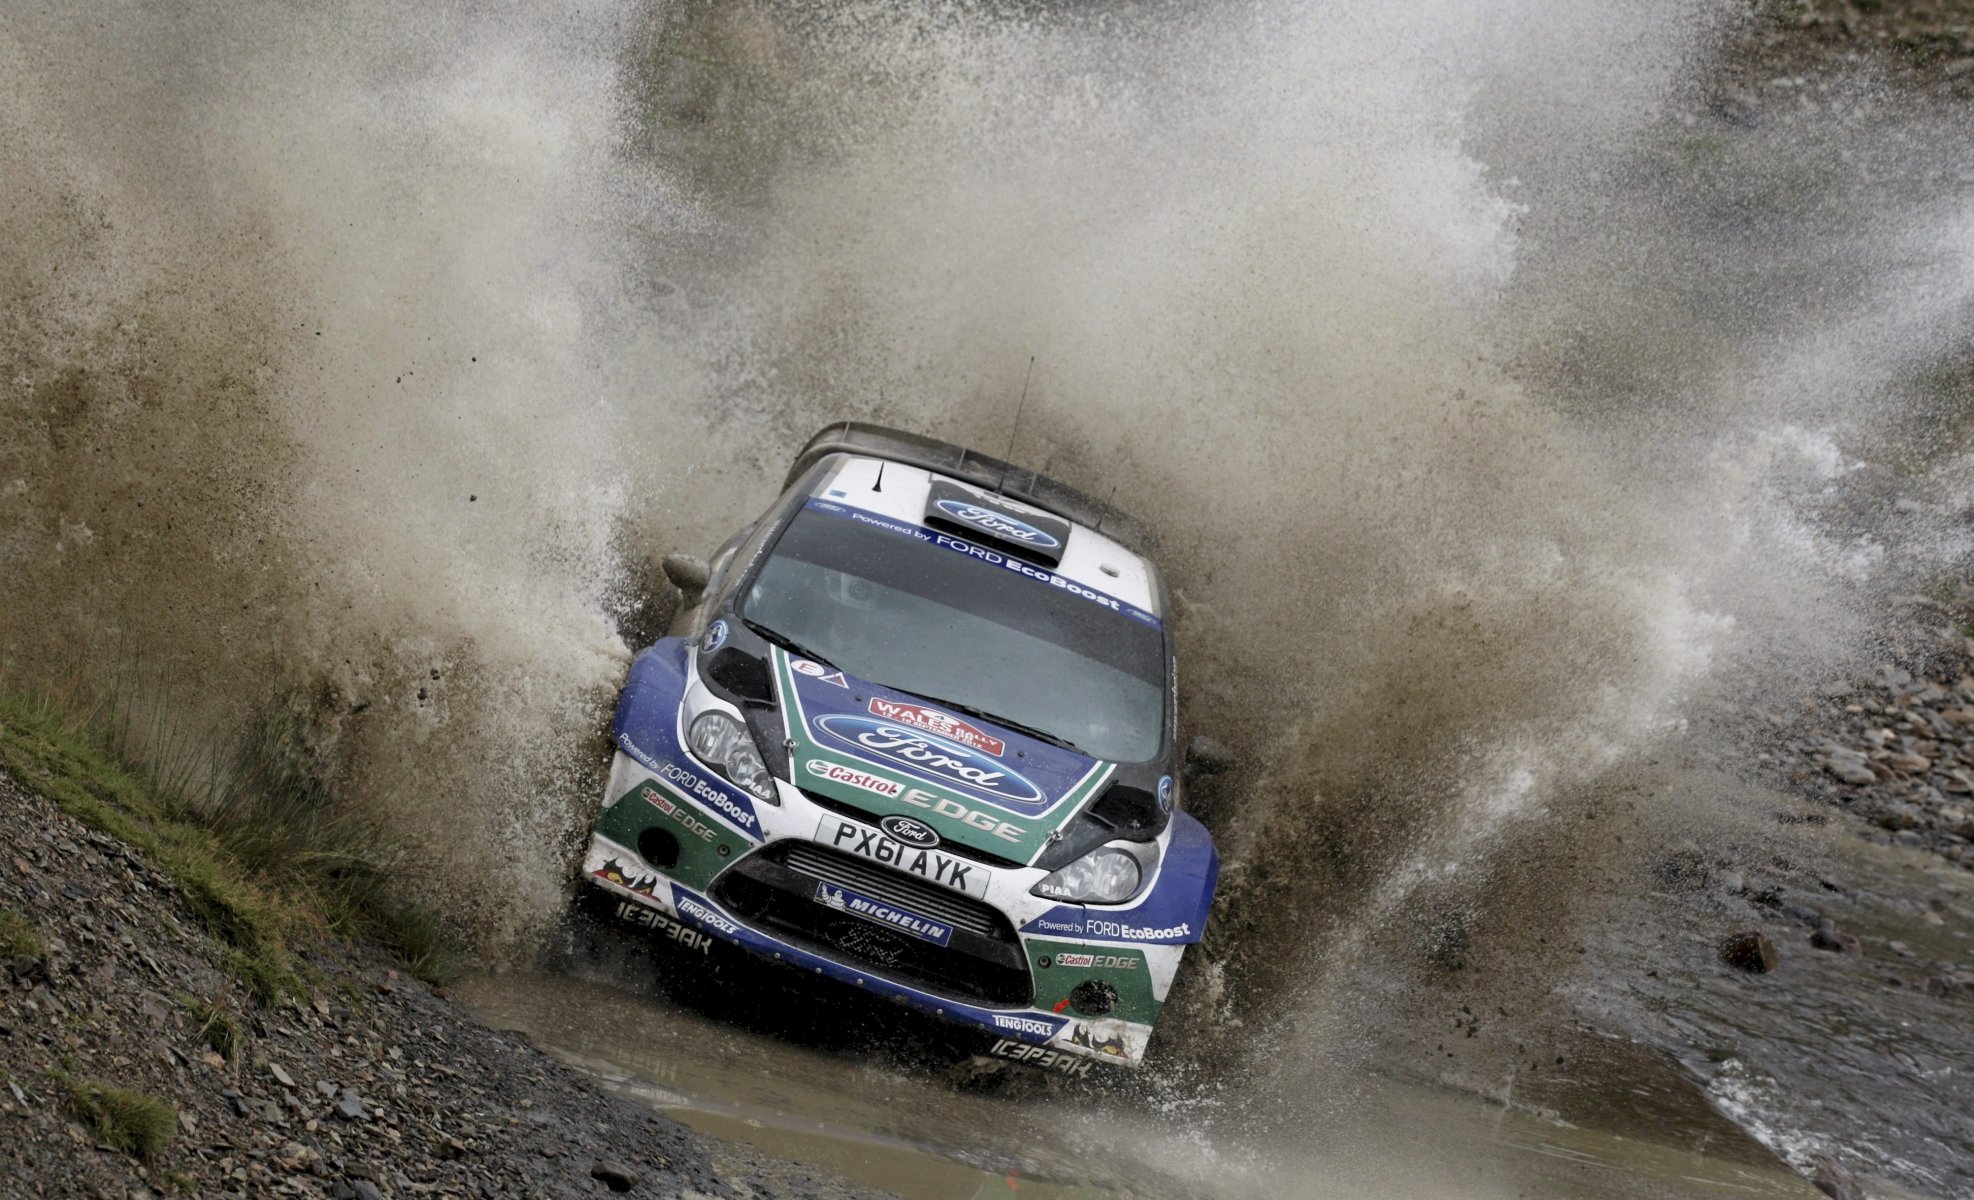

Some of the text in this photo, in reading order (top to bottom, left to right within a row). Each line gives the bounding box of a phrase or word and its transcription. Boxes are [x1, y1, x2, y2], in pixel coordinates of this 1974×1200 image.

[957, 507, 1037, 540] Ford
[852, 513, 1119, 611] Powered by FORD EcoBoost
[877, 702, 952, 732] WALES
[858, 727, 1005, 786] Ford
[620, 732, 651, 763] Powered
[661, 763, 698, 789] FORD
[693, 779, 755, 828] EcoBoost
[744, 779, 770, 799] PIAA
[649, 793, 718, 843] Castrol EDGE
[828, 767, 1027, 843] Castrol EDGE
[893, 821, 927, 841] Ford
[833, 822, 971, 890] PX61 AYK
[1041, 884, 1071, 897] PIAA
[850, 899, 944, 938] MICHELIN
[1038, 919, 1191, 939] Powered by FORD EcoBoost
[1065, 955, 1140, 970] Castrol EDGE
